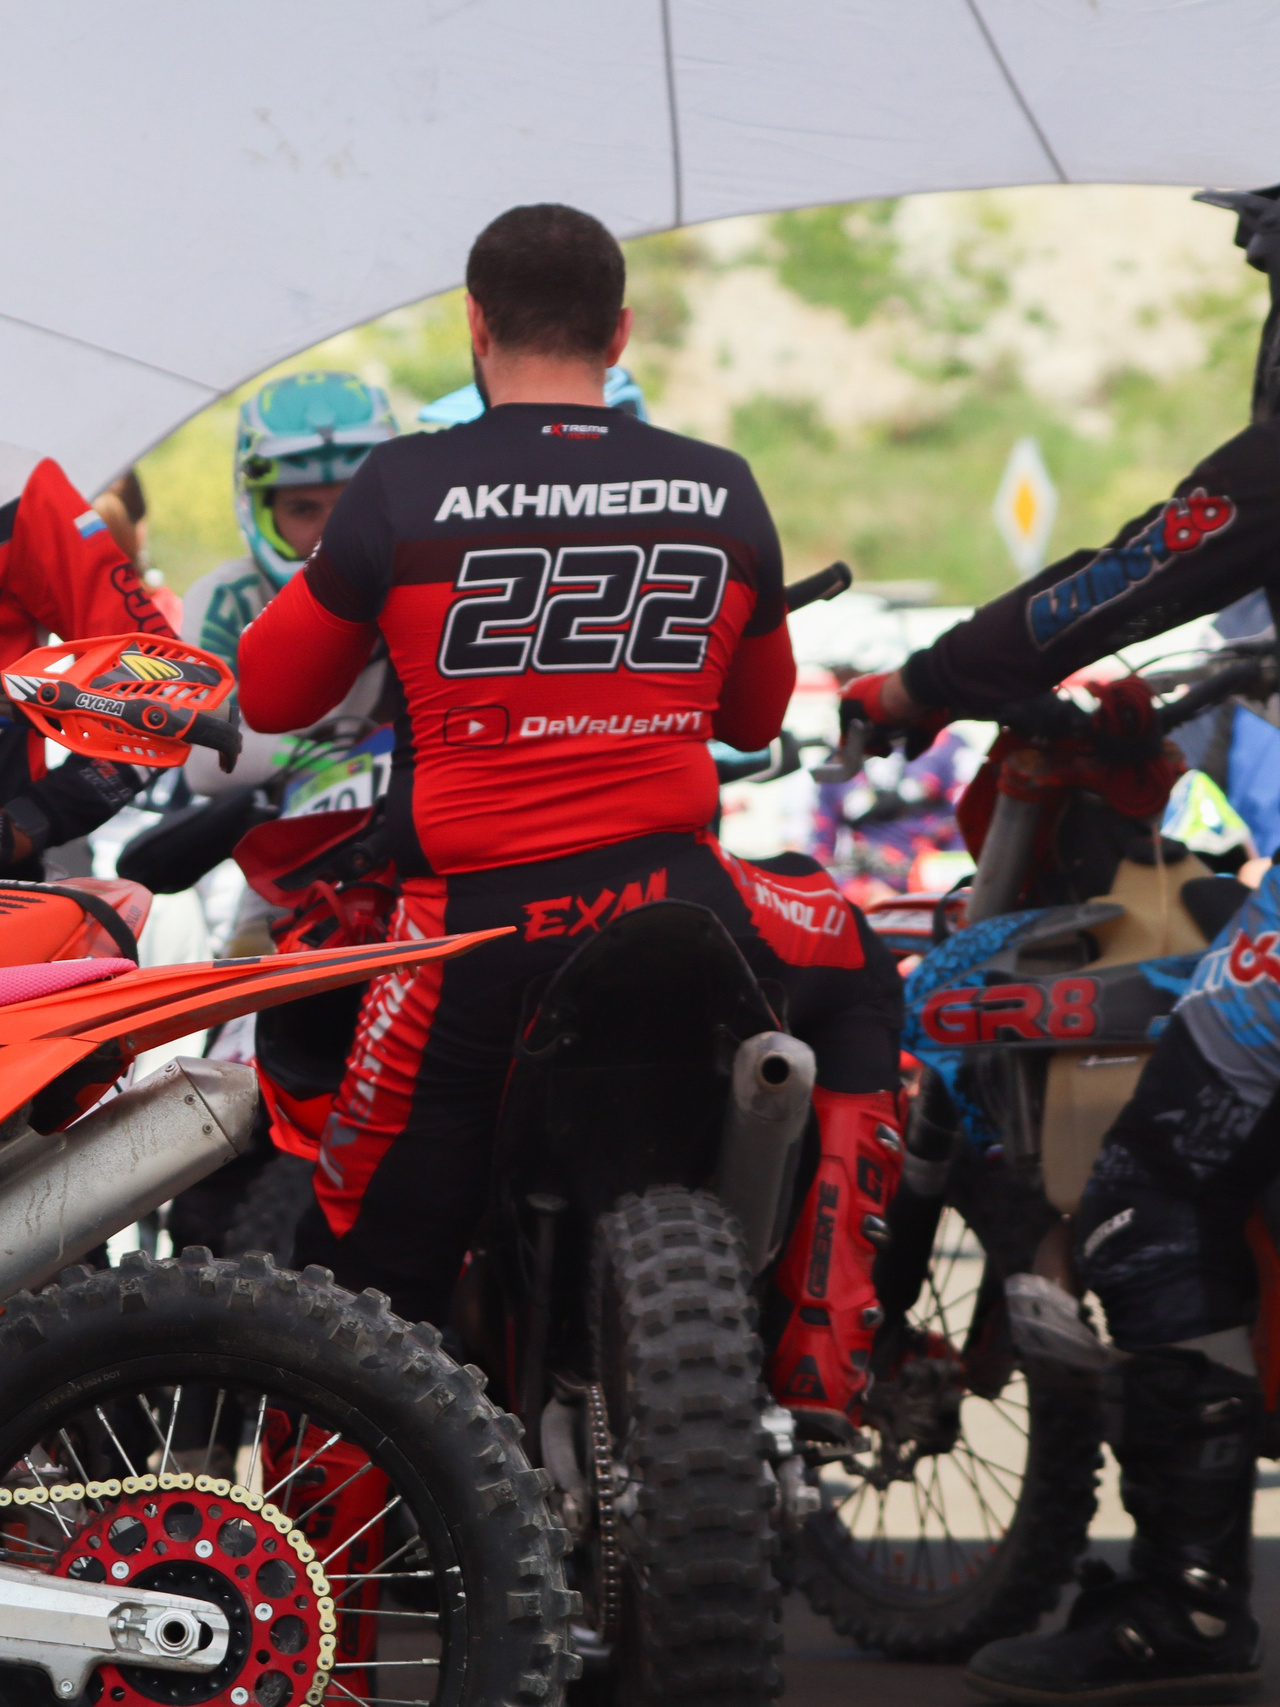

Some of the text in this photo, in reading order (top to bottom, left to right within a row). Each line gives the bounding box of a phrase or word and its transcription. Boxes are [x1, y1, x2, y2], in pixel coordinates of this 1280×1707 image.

[541, 422, 609, 437] EXTREME
[566, 432, 601, 440] MOTO
[434, 479, 728, 522] AKHMEDOV
[436, 543, 729, 678] 222
[75, 693, 126, 716] CYCRA
[920, 975, 1102, 1045] GR8
